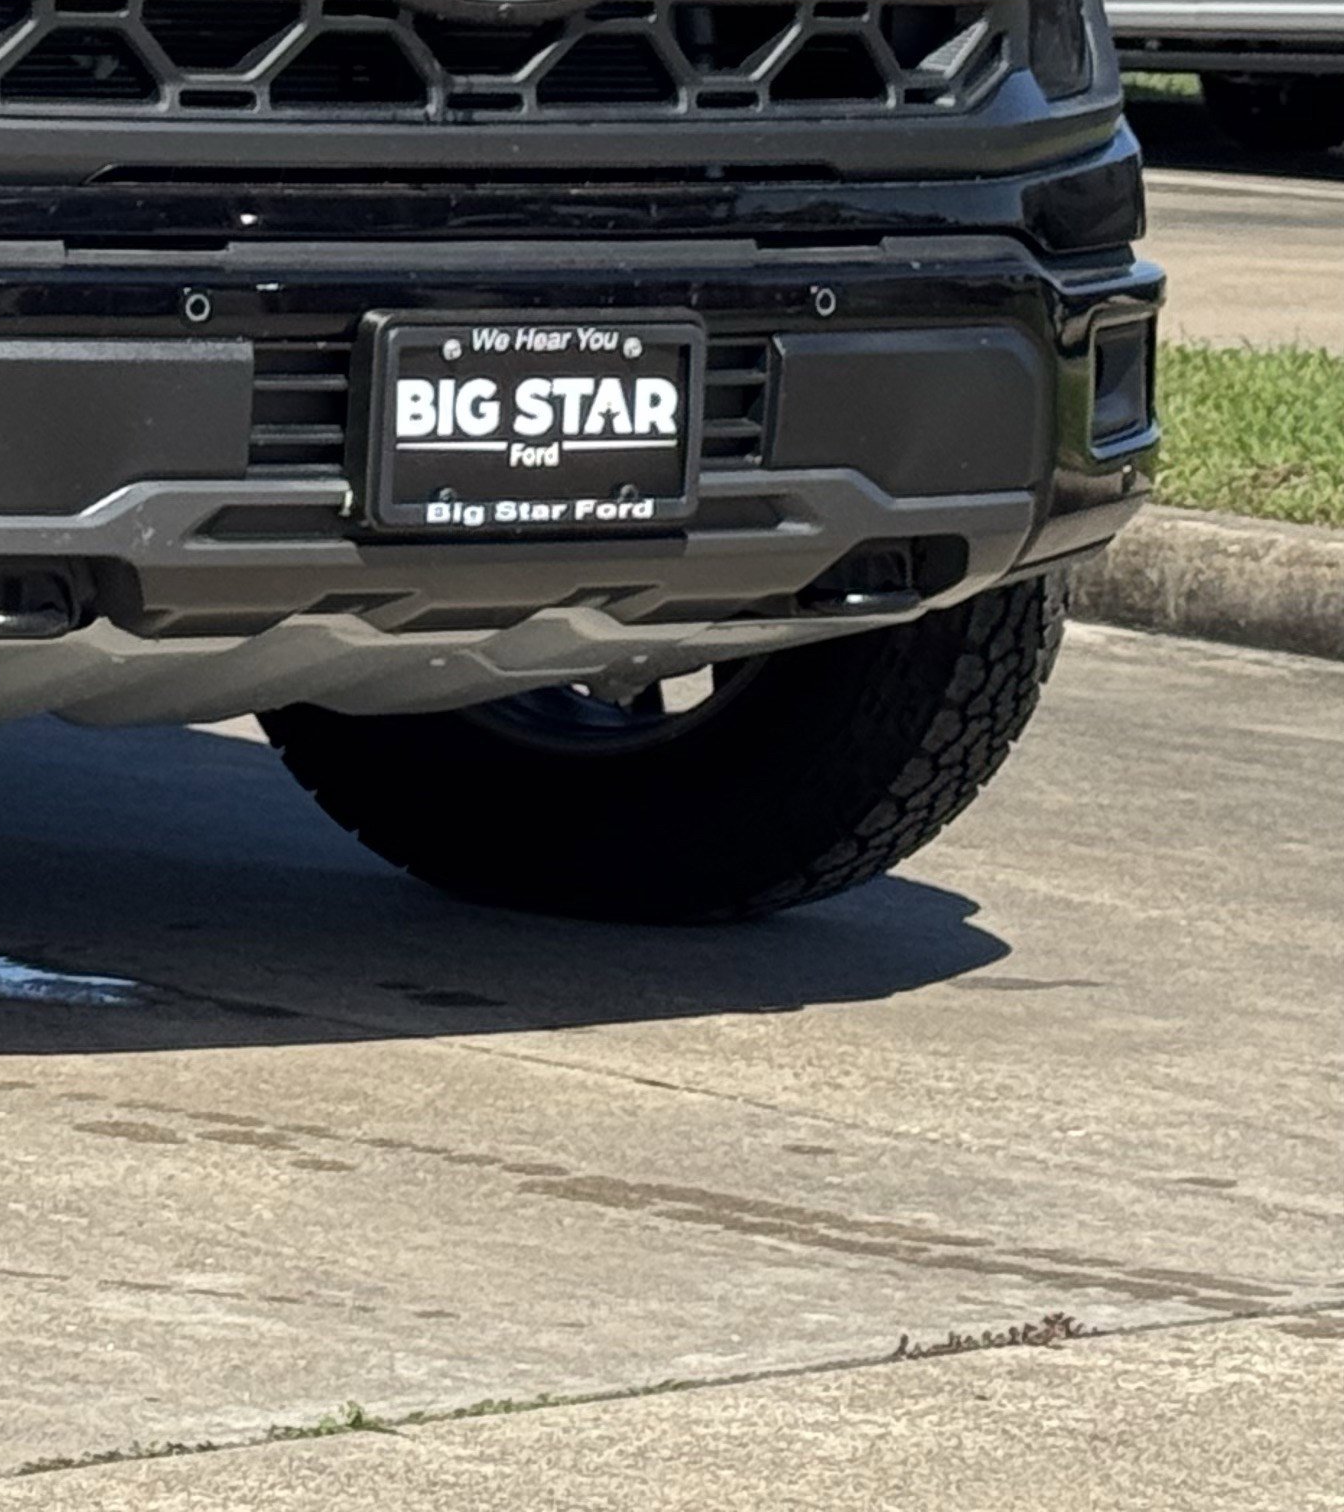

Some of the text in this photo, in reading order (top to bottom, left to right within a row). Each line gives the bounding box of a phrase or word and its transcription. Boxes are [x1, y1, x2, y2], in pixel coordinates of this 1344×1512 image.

[472, 326, 619, 352] We Hear You
[396, 377, 679, 438] BIG STAR
[509, 440, 561, 468] Ford
[426, 498, 655, 526] Big Star Ford
